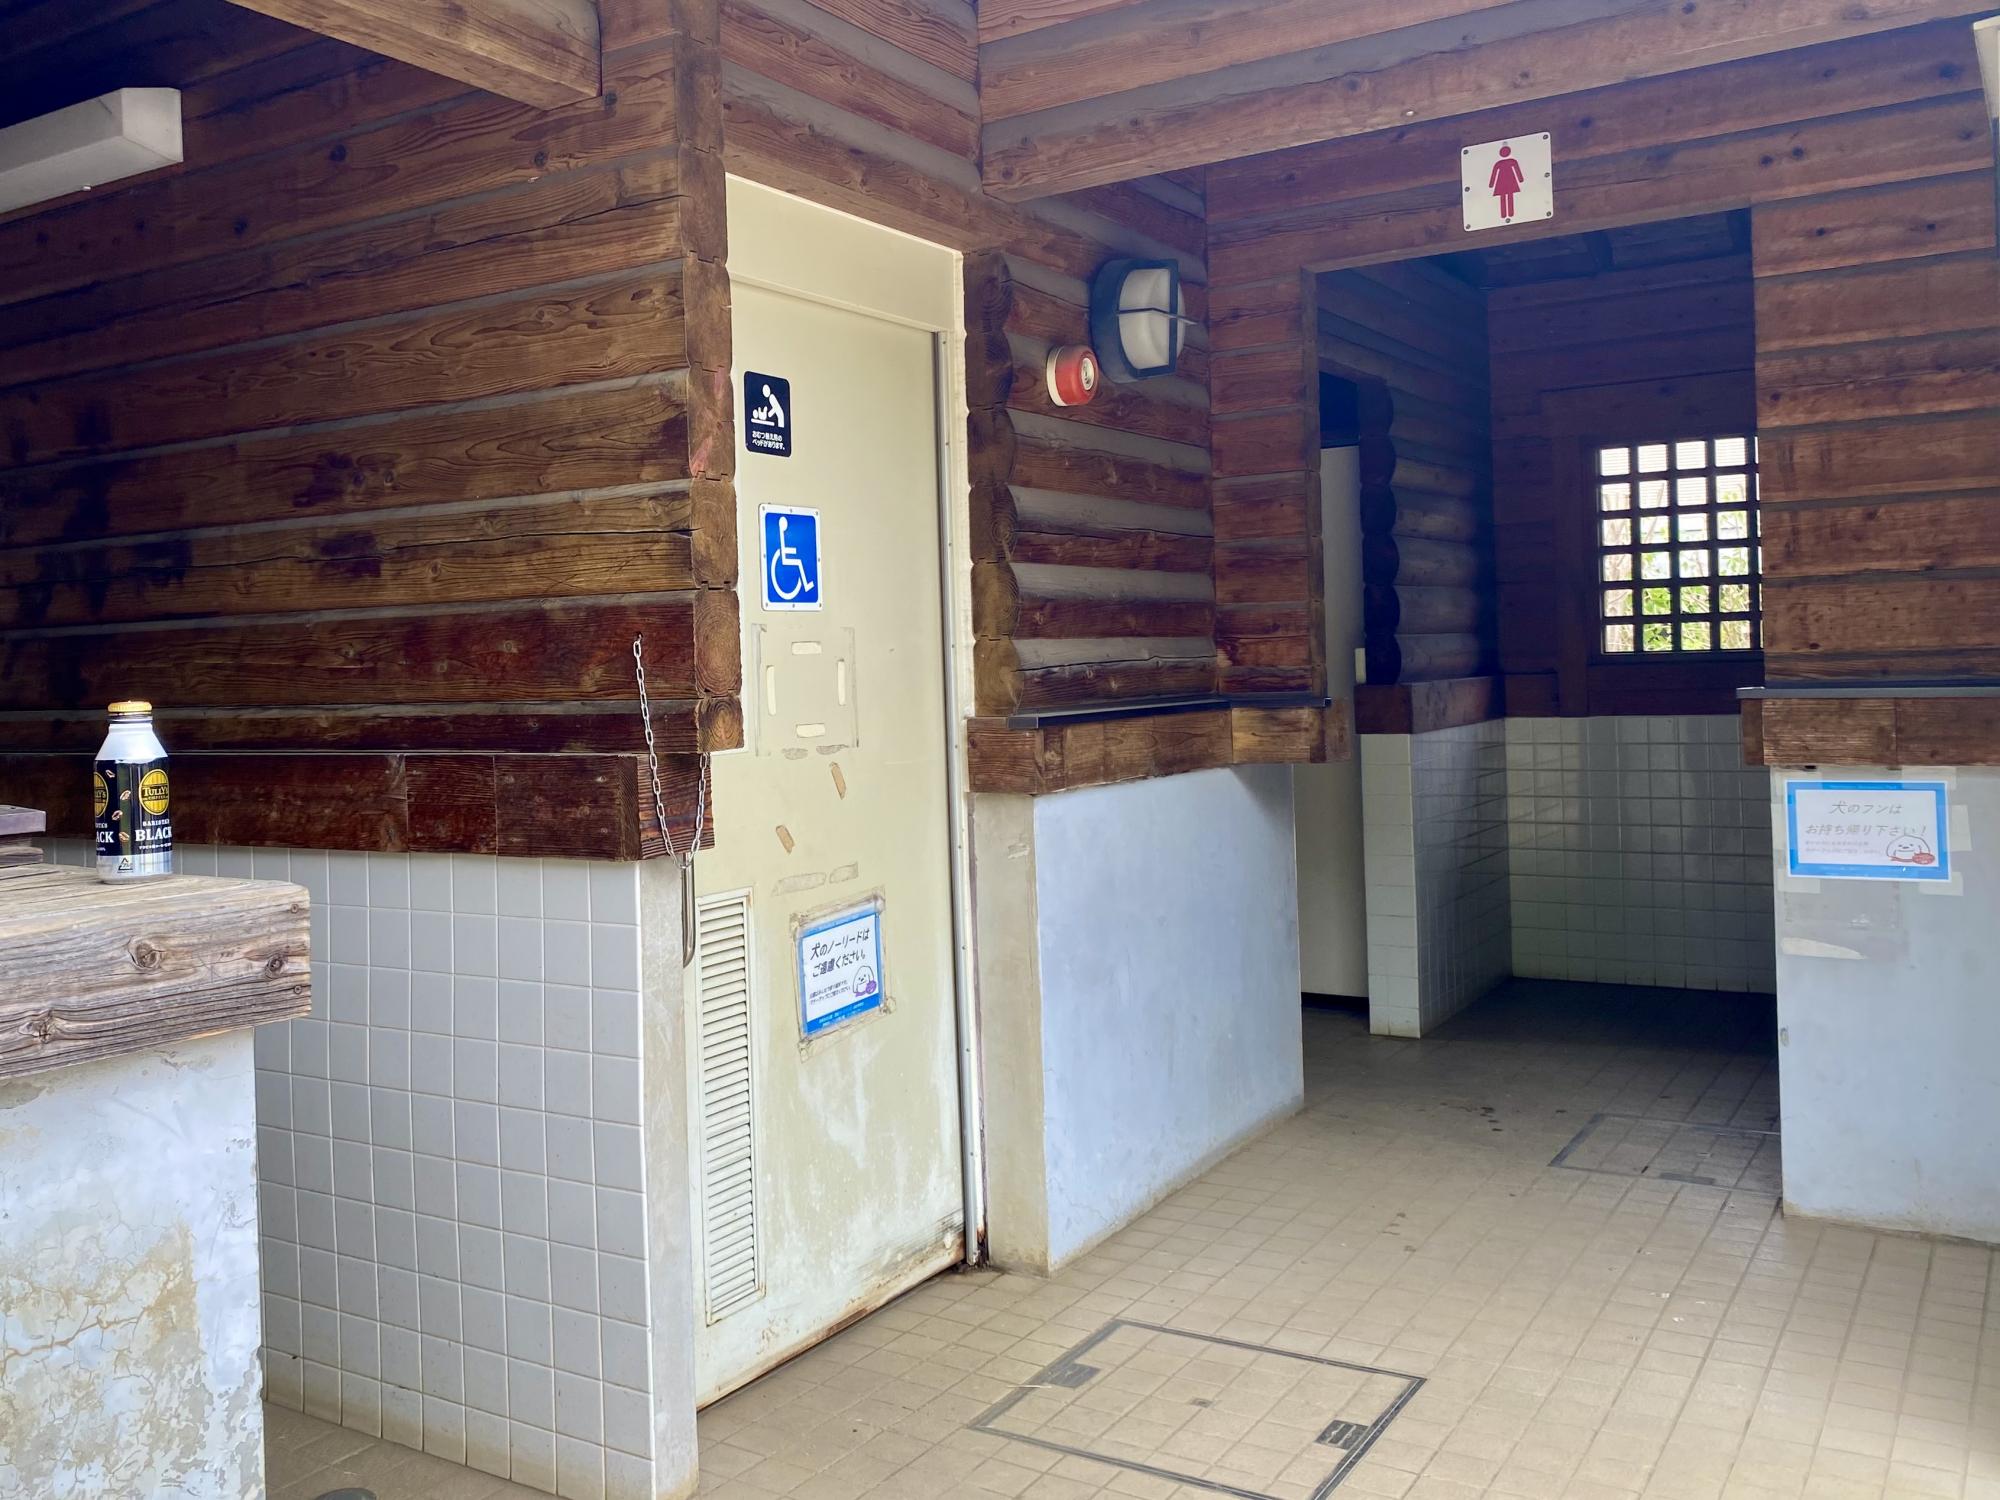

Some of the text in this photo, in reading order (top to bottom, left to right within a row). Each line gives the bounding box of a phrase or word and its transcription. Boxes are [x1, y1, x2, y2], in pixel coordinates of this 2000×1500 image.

[1829, 801, 1902, 814] 犬のフンは
[96, 831, 115, 843] ACK
[810, 928, 869, 960] 犬のノーリードは
